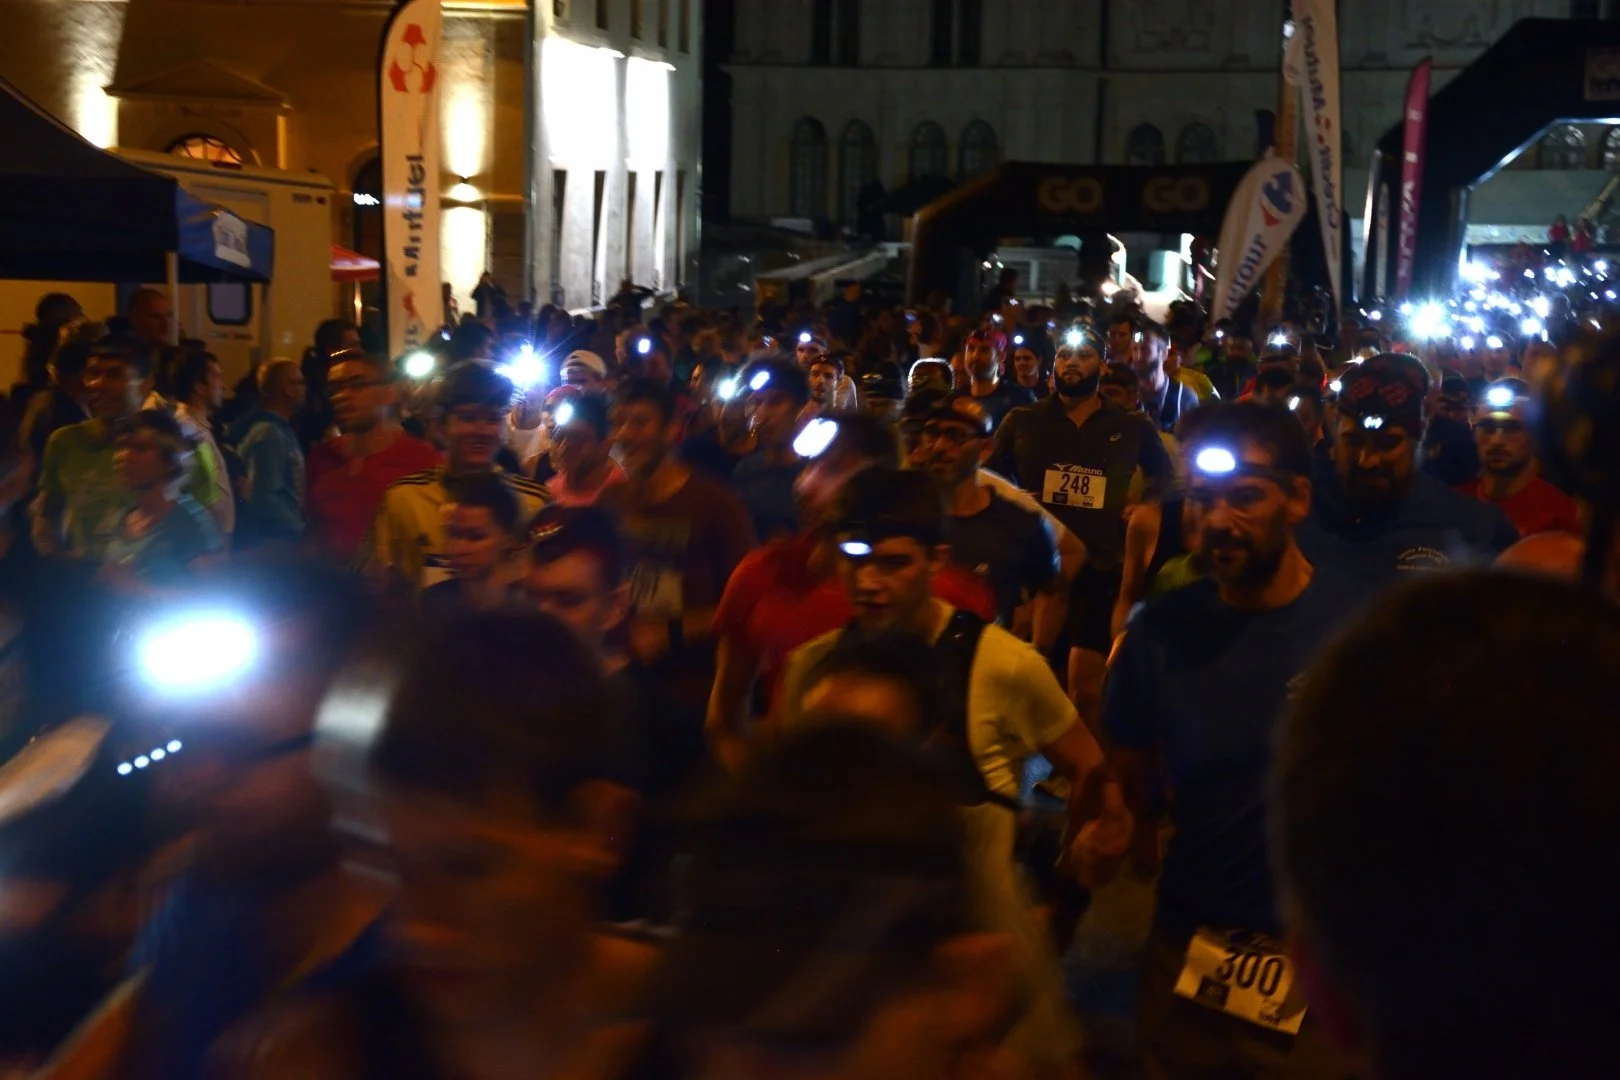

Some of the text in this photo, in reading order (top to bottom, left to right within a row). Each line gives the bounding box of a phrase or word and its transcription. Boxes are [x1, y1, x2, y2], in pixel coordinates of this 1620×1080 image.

[1038, 176, 1104, 214] GO
[1142, 176, 1209, 214] GO
[1059, 474, 1091, 496] 248
[1216, 947, 1283, 997] 300
